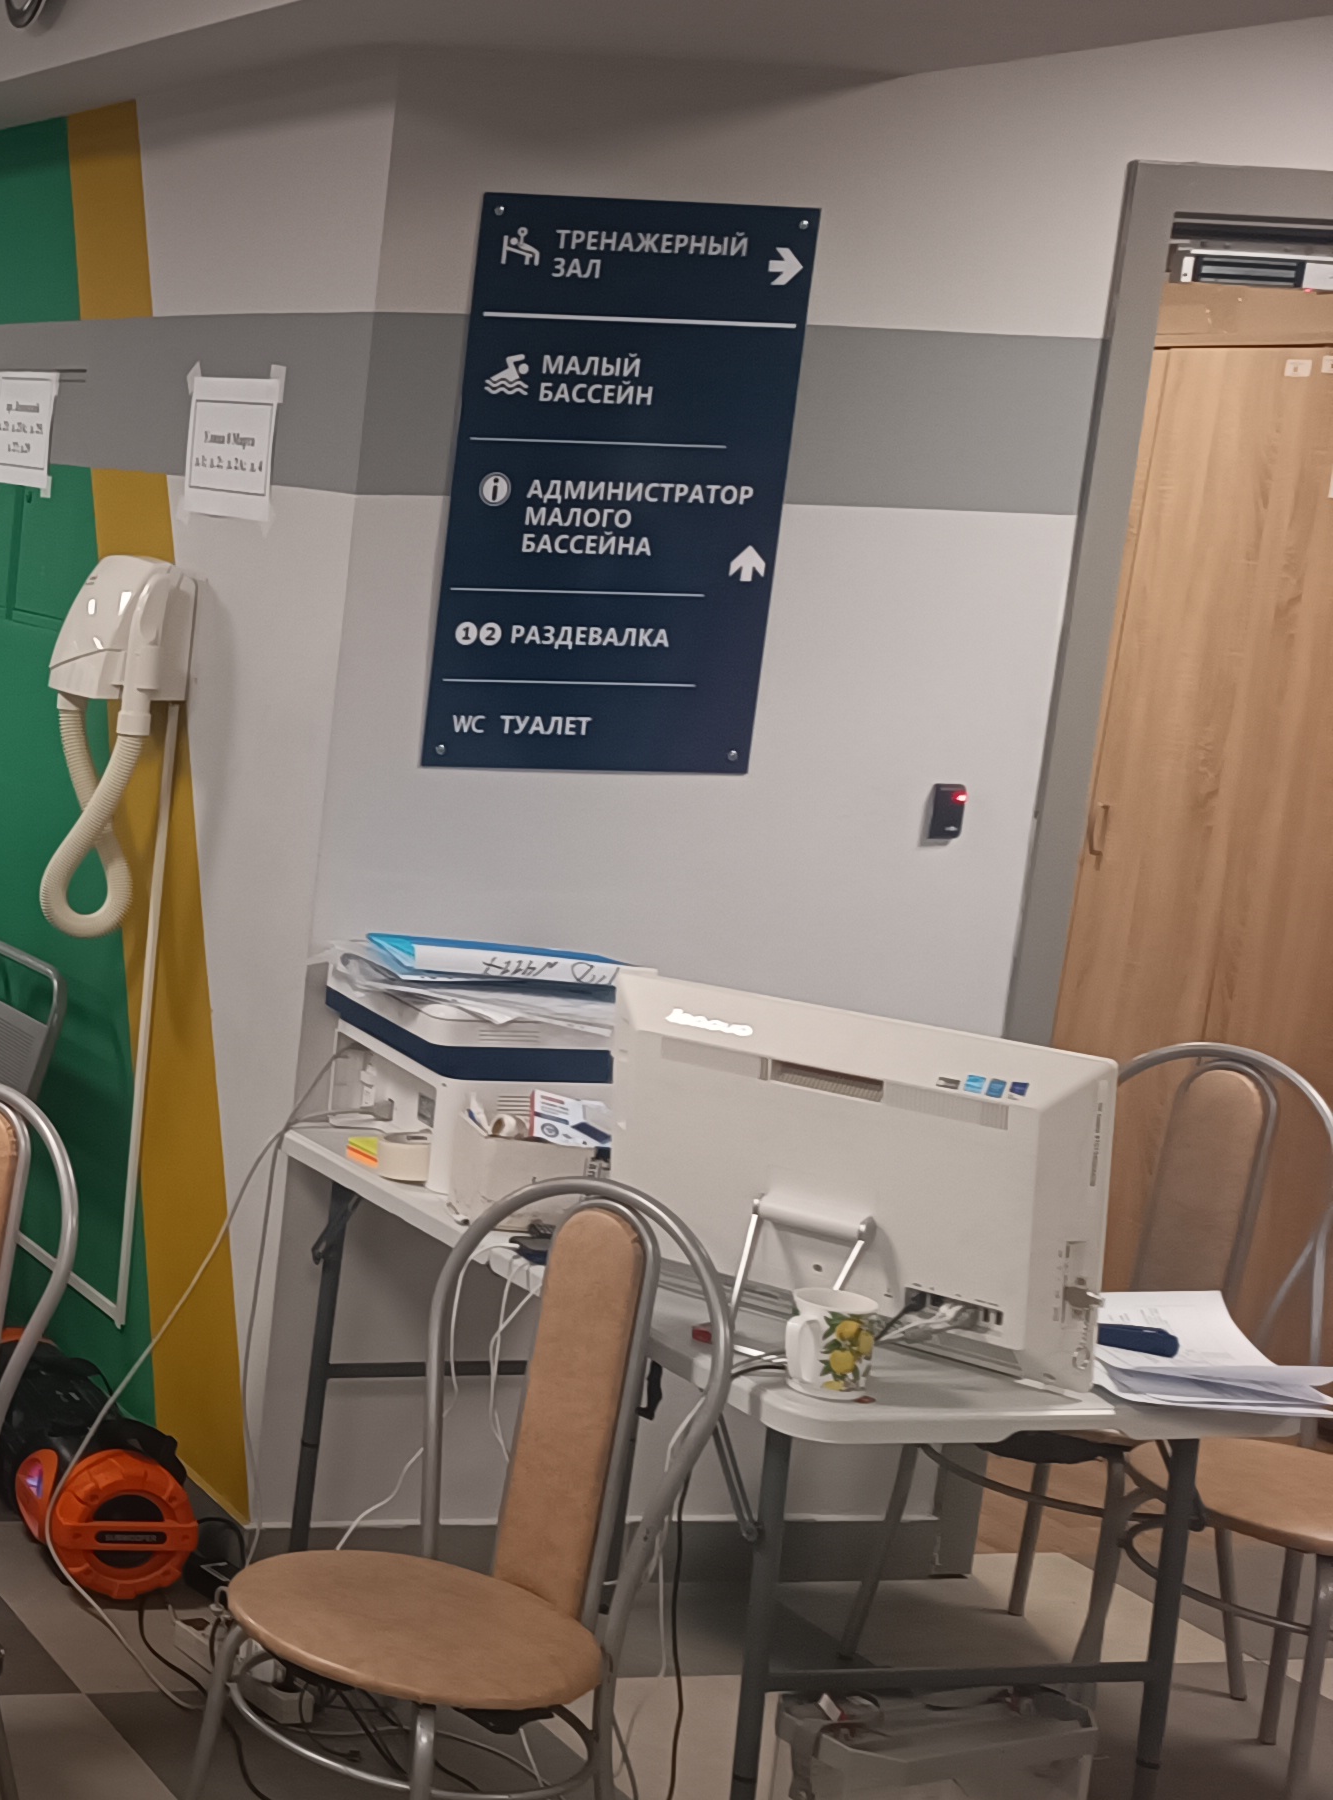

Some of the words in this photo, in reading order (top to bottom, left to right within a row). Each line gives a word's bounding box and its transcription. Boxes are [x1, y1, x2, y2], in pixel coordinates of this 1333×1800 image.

[555, 229, 749, 258] ТРЕНАЖЕРНЫЙ
[551, 258, 602, 279] ЗАЛ
[541, 353, 641, 378] МАЛЫЙ
[538, 381, 654, 406] БАССЕЙН
[526, 479, 754, 506] АДМИНИСТРАТОР
[524, 507, 632, 529] МАЛОГО
[521, 531, 652, 557] БАССЕЙНА
[510, 624, 670, 650] РАЗДЕВАЛКА
[452, 714, 486, 734] WC
[499, 714, 593, 736] ТУАЛЕТ
